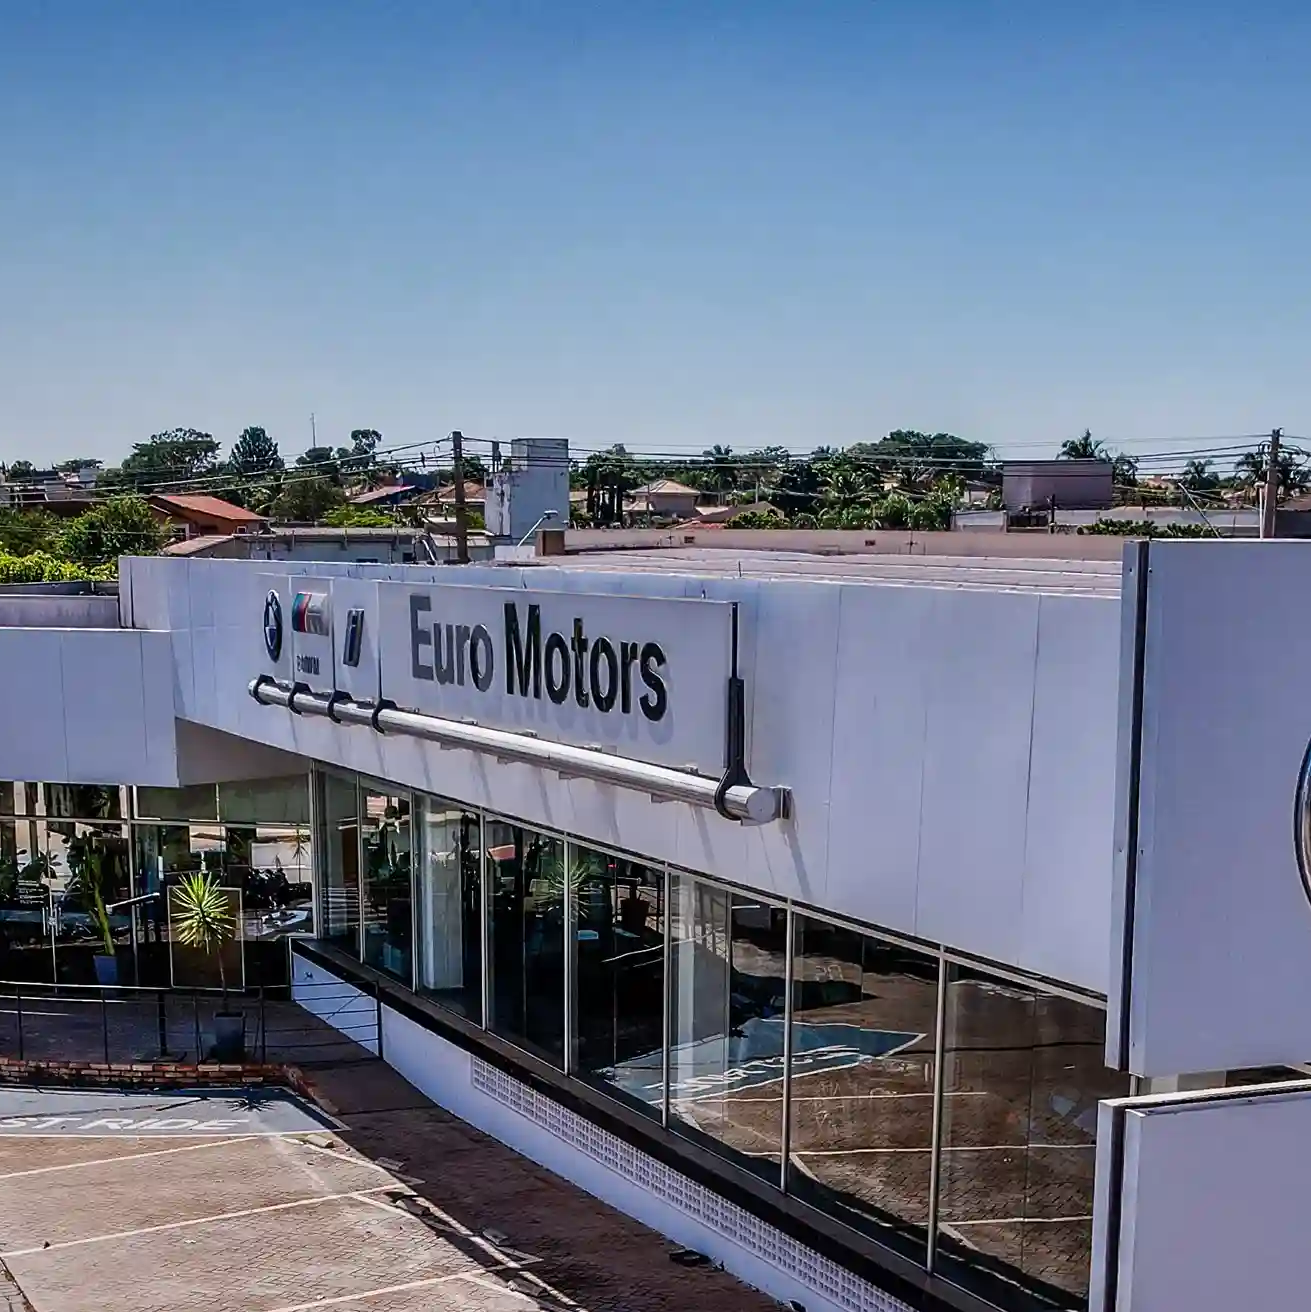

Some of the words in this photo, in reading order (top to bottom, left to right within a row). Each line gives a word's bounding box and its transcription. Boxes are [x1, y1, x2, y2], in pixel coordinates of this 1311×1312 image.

[409, 593, 494, 692] Euro
[504, 601, 668, 722] Motors
[77, 1118, 251, 1131] RIDE
